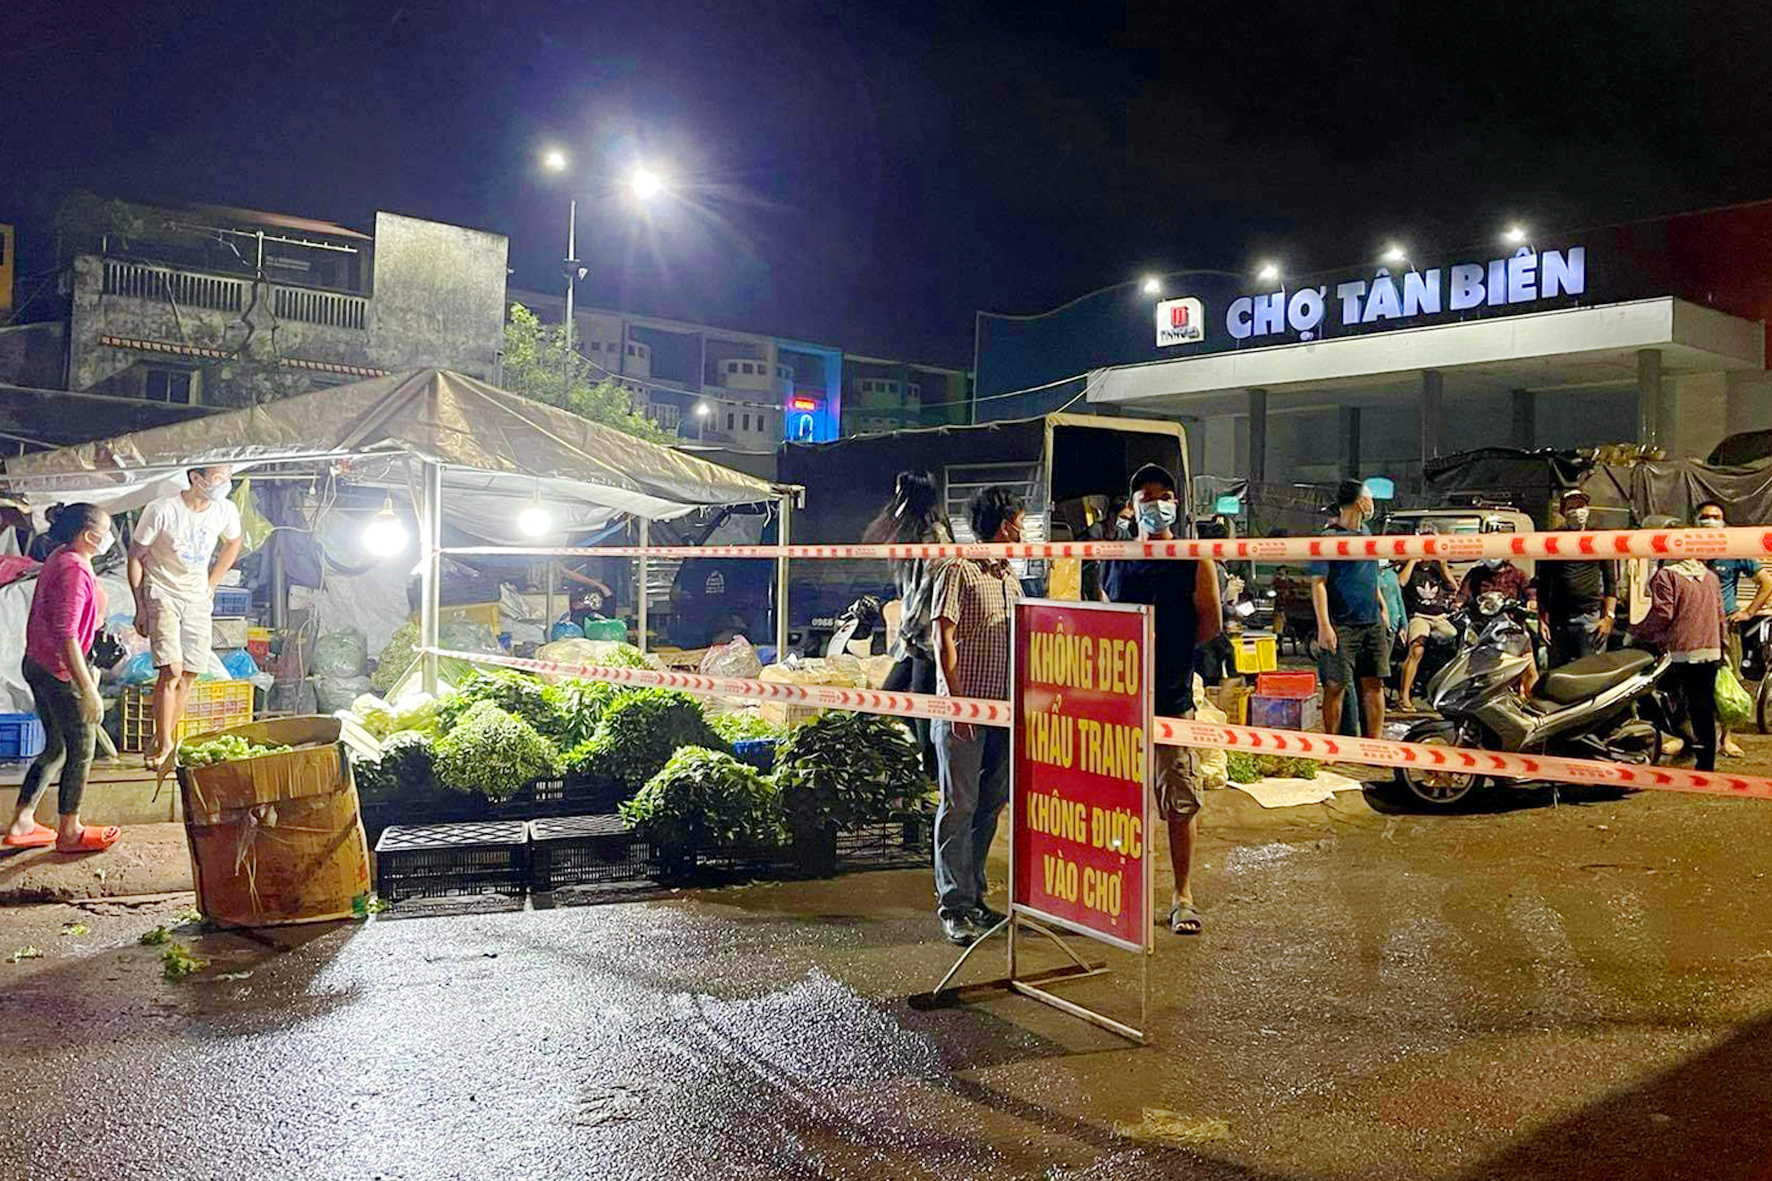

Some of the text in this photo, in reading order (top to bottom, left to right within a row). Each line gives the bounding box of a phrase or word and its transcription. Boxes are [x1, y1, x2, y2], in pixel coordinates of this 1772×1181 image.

[1226, 246, 1586, 341] CHỢ TÂN BIÊN
[1030, 622, 1139, 696] KHÔNG ĐEO
[1026, 693, 1143, 784] KHẨU TRANG
[1027, 789, 1142, 865] KHÔNG ĐƯỢC
[1043, 849, 1123, 926] VÀO CHỢ
